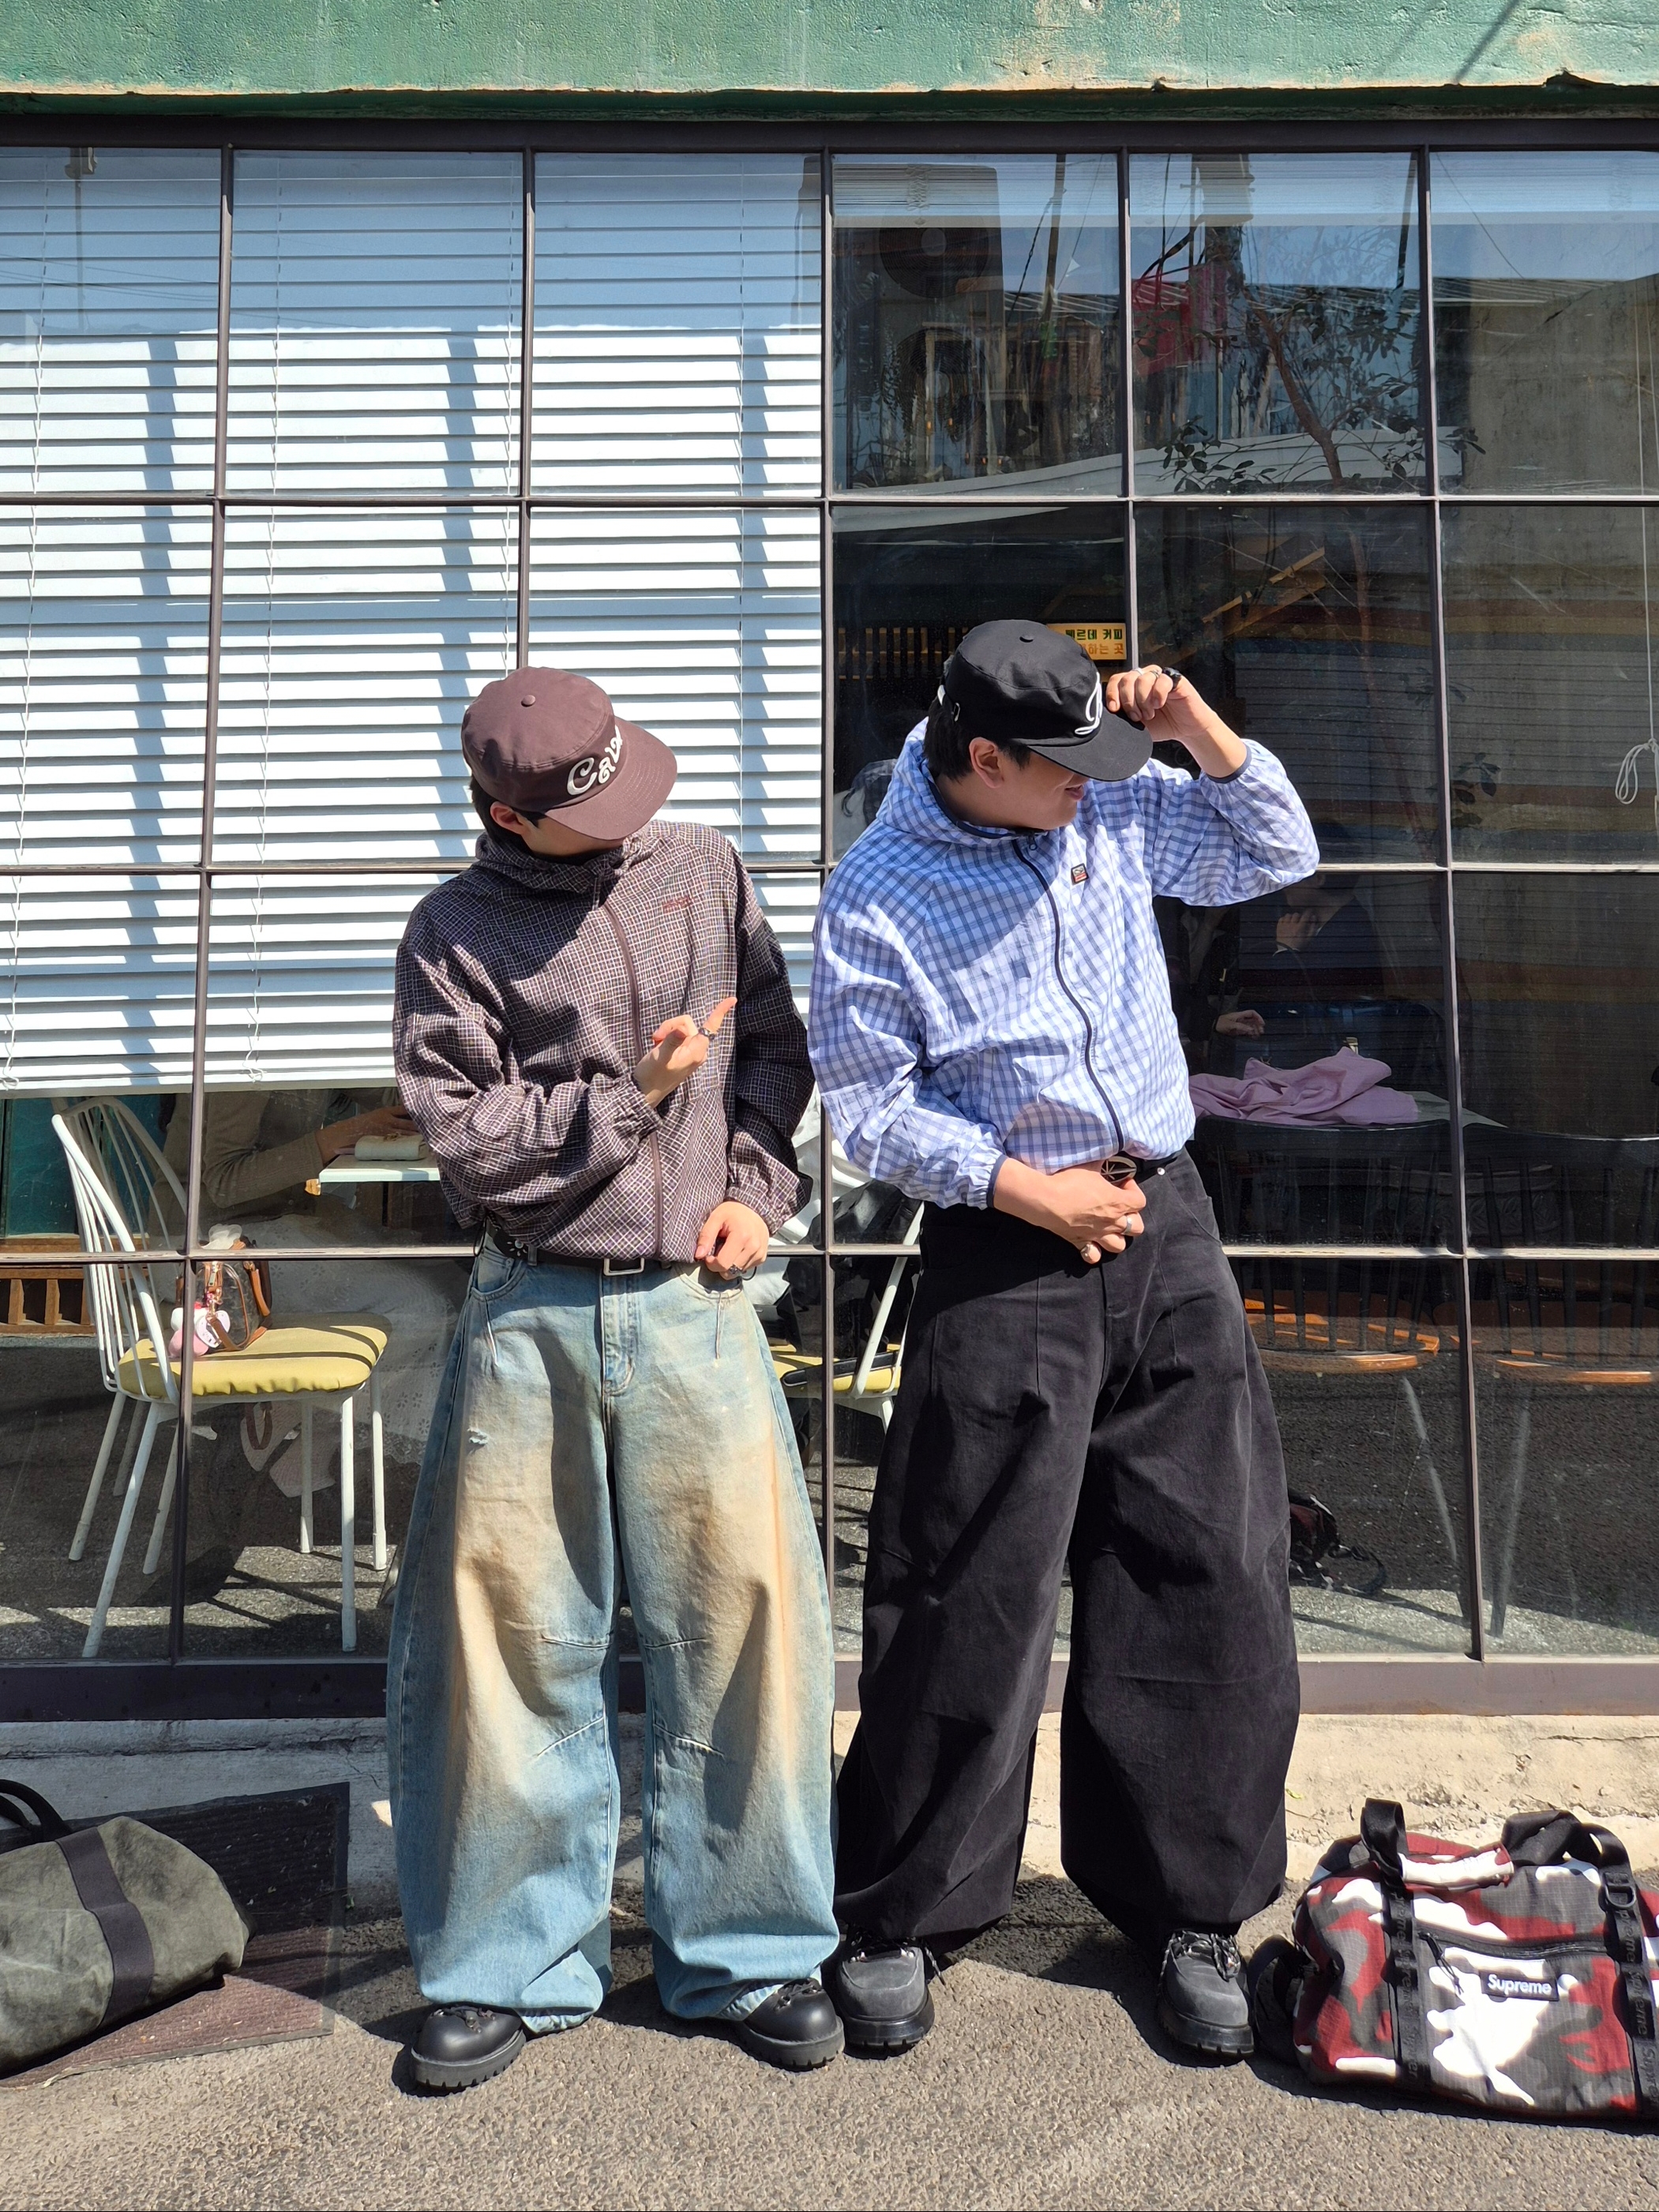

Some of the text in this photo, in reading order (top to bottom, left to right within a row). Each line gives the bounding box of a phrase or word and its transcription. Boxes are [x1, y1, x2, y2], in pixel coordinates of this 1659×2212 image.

[1103, 628, 1123, 640] 커피
[1082, 643, 1124, 654] 하는 곳
[1488, 1974, 1552, 1996] Supreme
